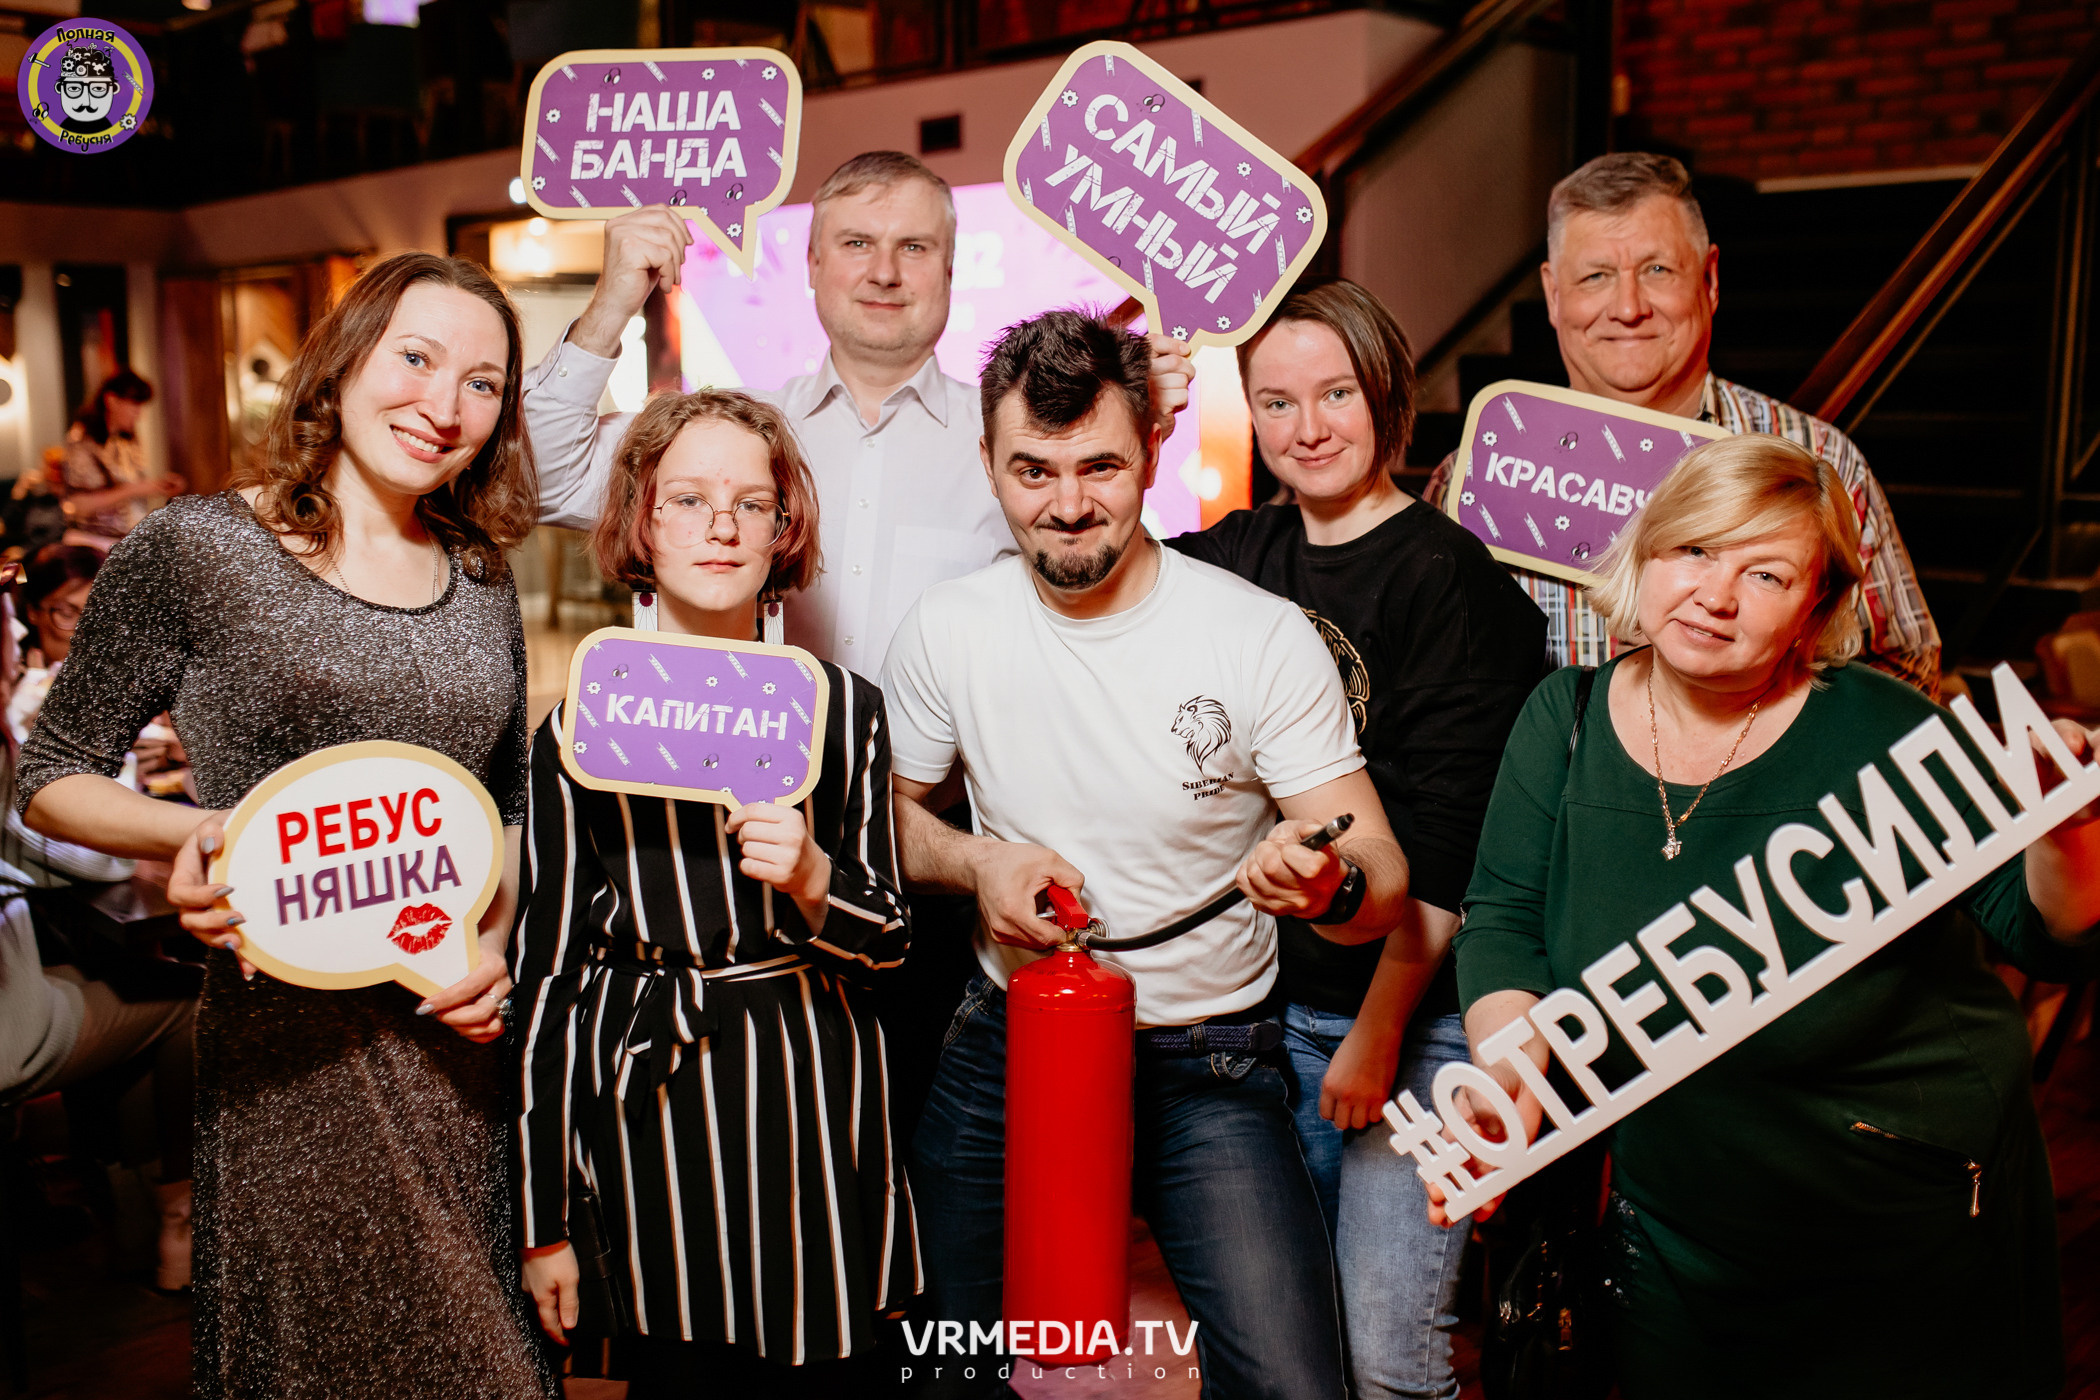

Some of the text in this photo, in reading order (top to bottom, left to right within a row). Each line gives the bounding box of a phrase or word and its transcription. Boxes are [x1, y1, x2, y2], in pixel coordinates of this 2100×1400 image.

[585, 90, 742, 133] НАША
[570, 137, 748, 187] БАНДА
[1084, 93, 1282, 255] САМЫЙ
[1044, 143, 1239, 304] УМНЫЙ
[606, 693, 788, 741] КАПИТАН
[276, 787, 443, 865] РЕБУС
[1193, 784, 1226, 801] PRIDE
[274, 845, 463, 926] НЯШКА
[1382, 661, 2098, 1222] #ОТРЕБУСИЛИ
